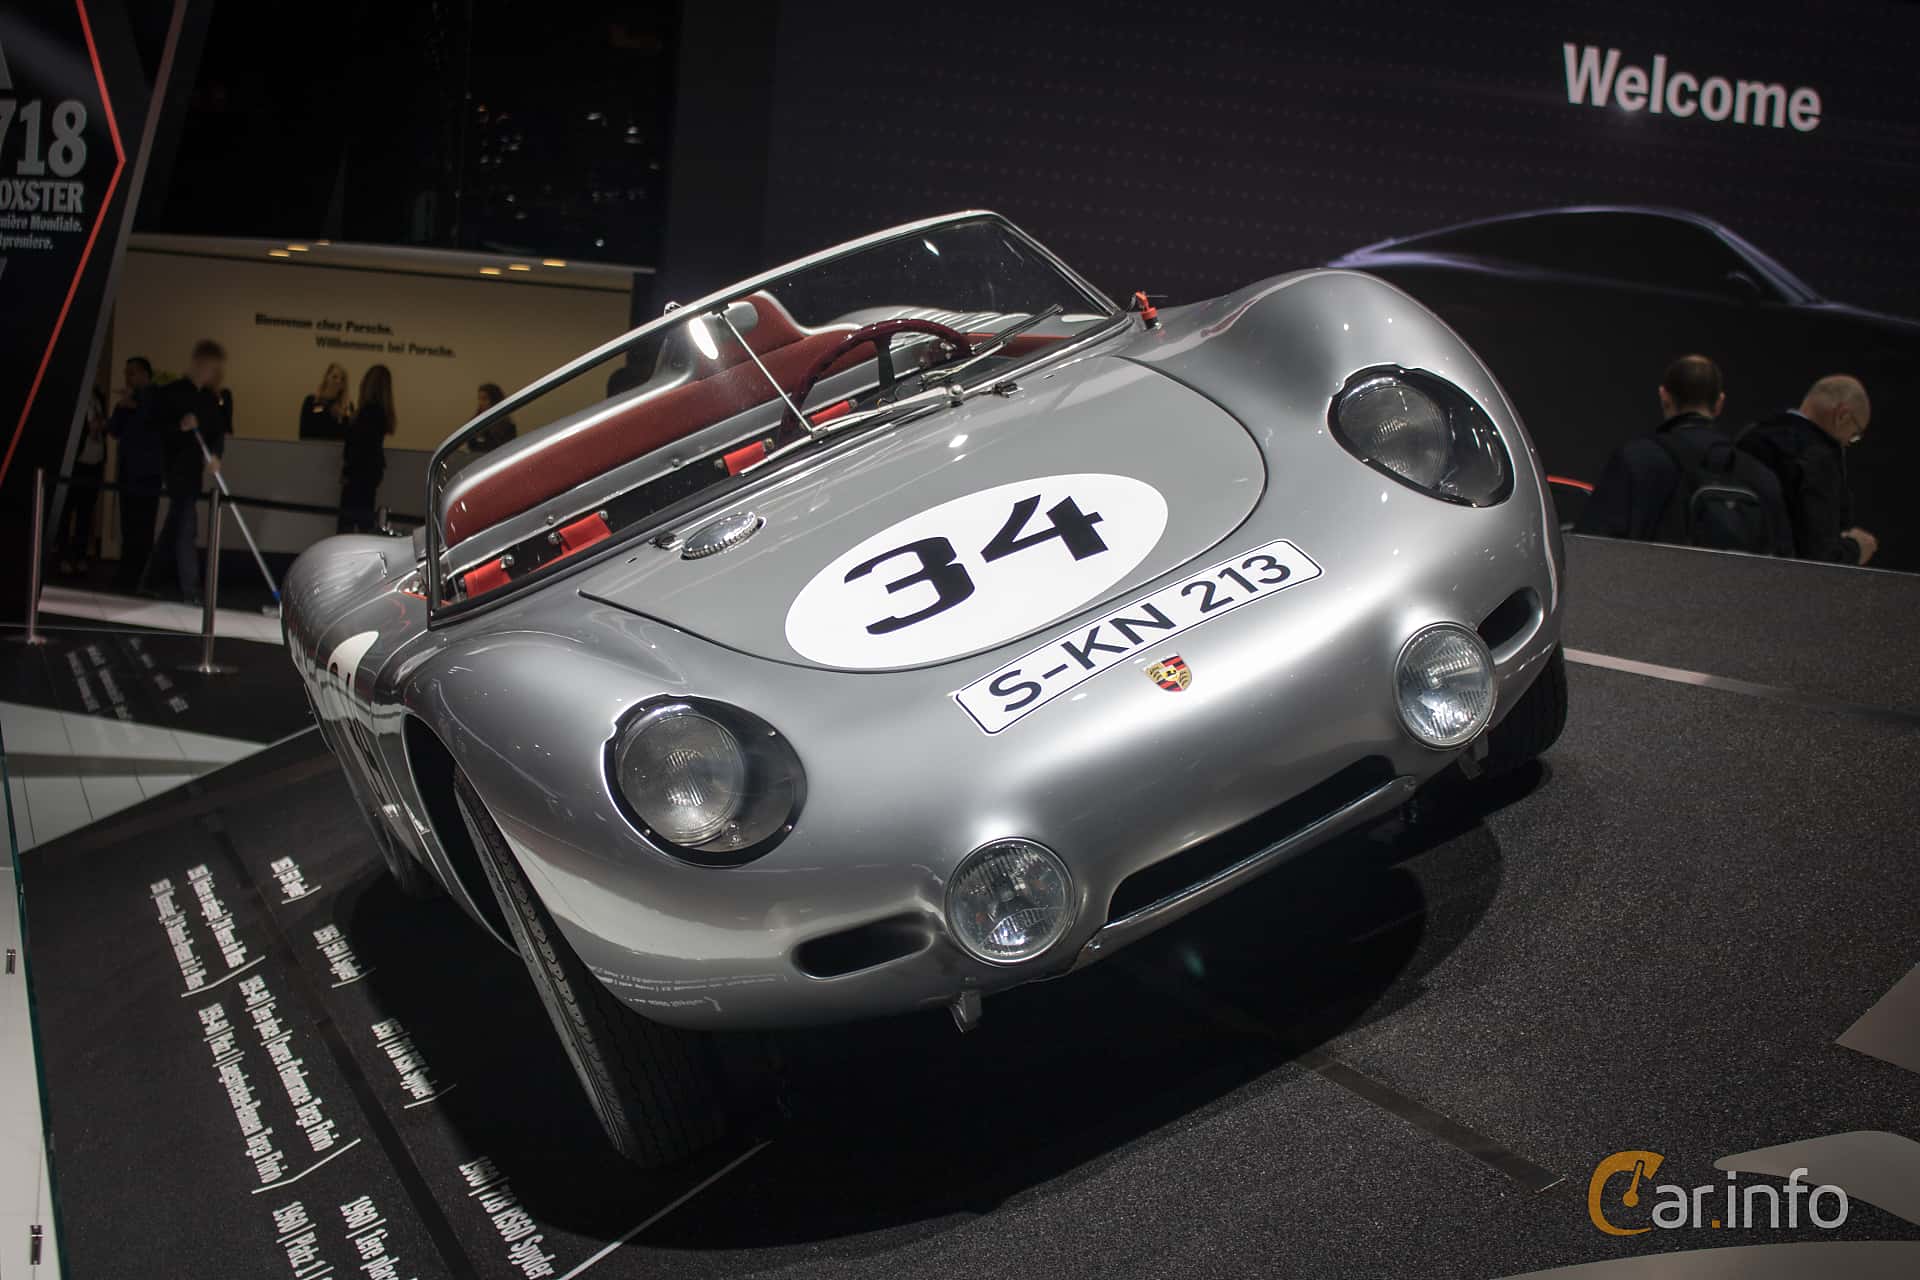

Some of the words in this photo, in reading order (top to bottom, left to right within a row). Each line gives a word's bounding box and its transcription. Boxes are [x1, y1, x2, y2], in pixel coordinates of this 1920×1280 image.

[1563, 43, 1822, 132] Welcome
[844, 494, 1108, 634] 34
[989, 603, 1176, 713] S-KN
[1181, 554, 1291, 614] 213
[340, 1196, 379, 1229] 1960
[506, 1233, 557, 1280] Spyder
